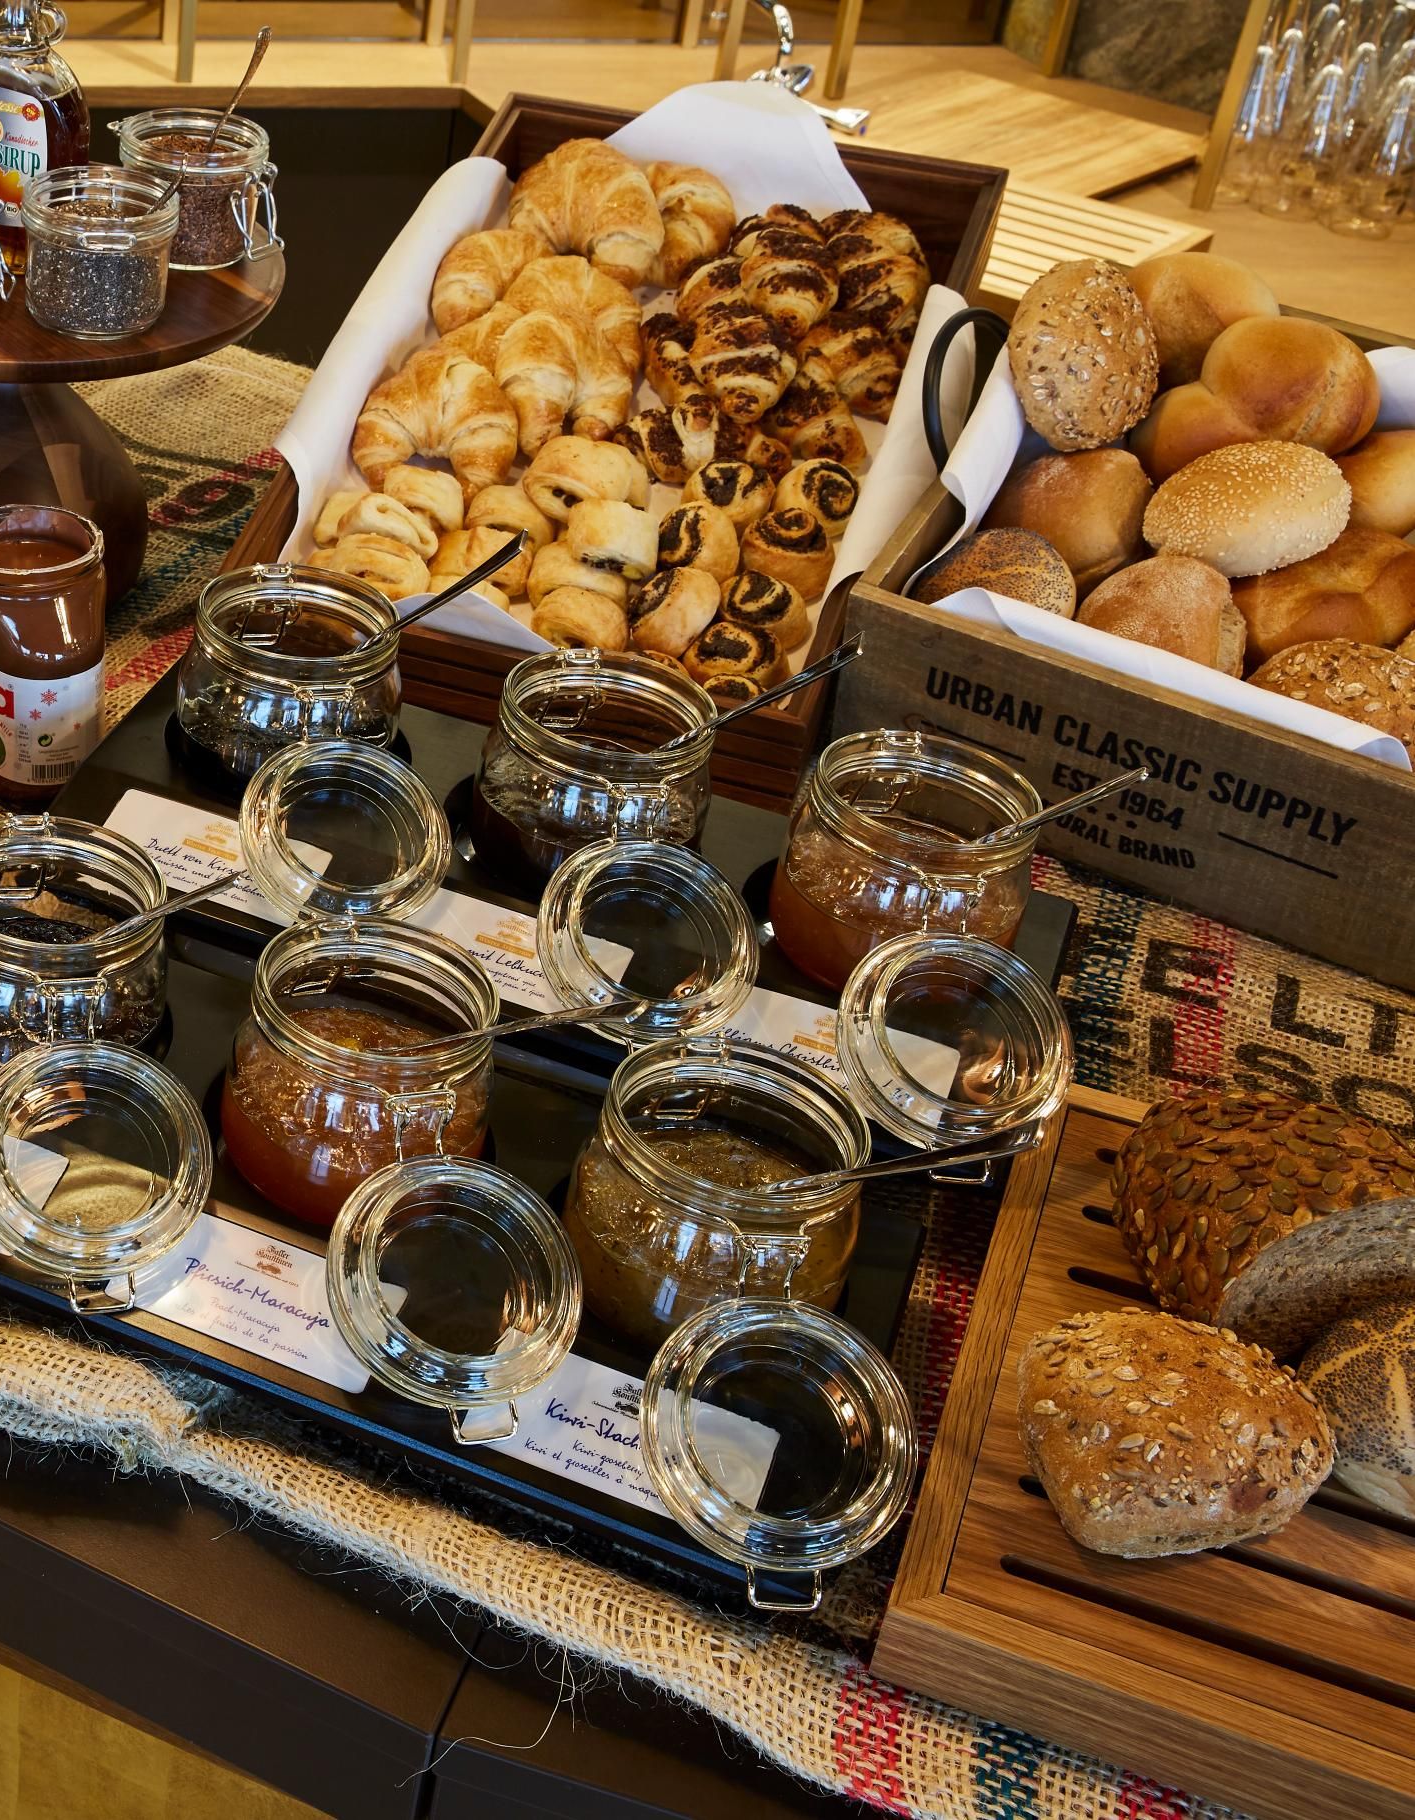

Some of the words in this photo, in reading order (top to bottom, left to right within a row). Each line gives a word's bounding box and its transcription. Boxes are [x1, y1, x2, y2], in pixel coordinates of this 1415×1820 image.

[925, 666, 1043, 736] URBAN
[1053, 714, 1202, 792] CLASSIC
[1208, 770, 1358, 847] SUPPLY
[1118, 788, 1184, 830] 1964
[145, 836, 183, 857] Duett
[185, 853, 203, 866] von
[1117, 838, 1196, 870] BRAND
[191, 869, 212, 881] und
[185, 1257, 330, 1331] Pfirsich-Maracuja
[242, 1328, 254, 1338] de
[257, 1332, 270, 1344] la
[272, 1342, 308, 1360] passion
[545, 1397, 642, 1450] Kiwi-Stach
[524, 1437, 547, 1455] Kiwi
[552, 1451, 561, 1460] et
[565, 1457, 610, 1480] groseilles
[616, 1474, 624, 1484] à
